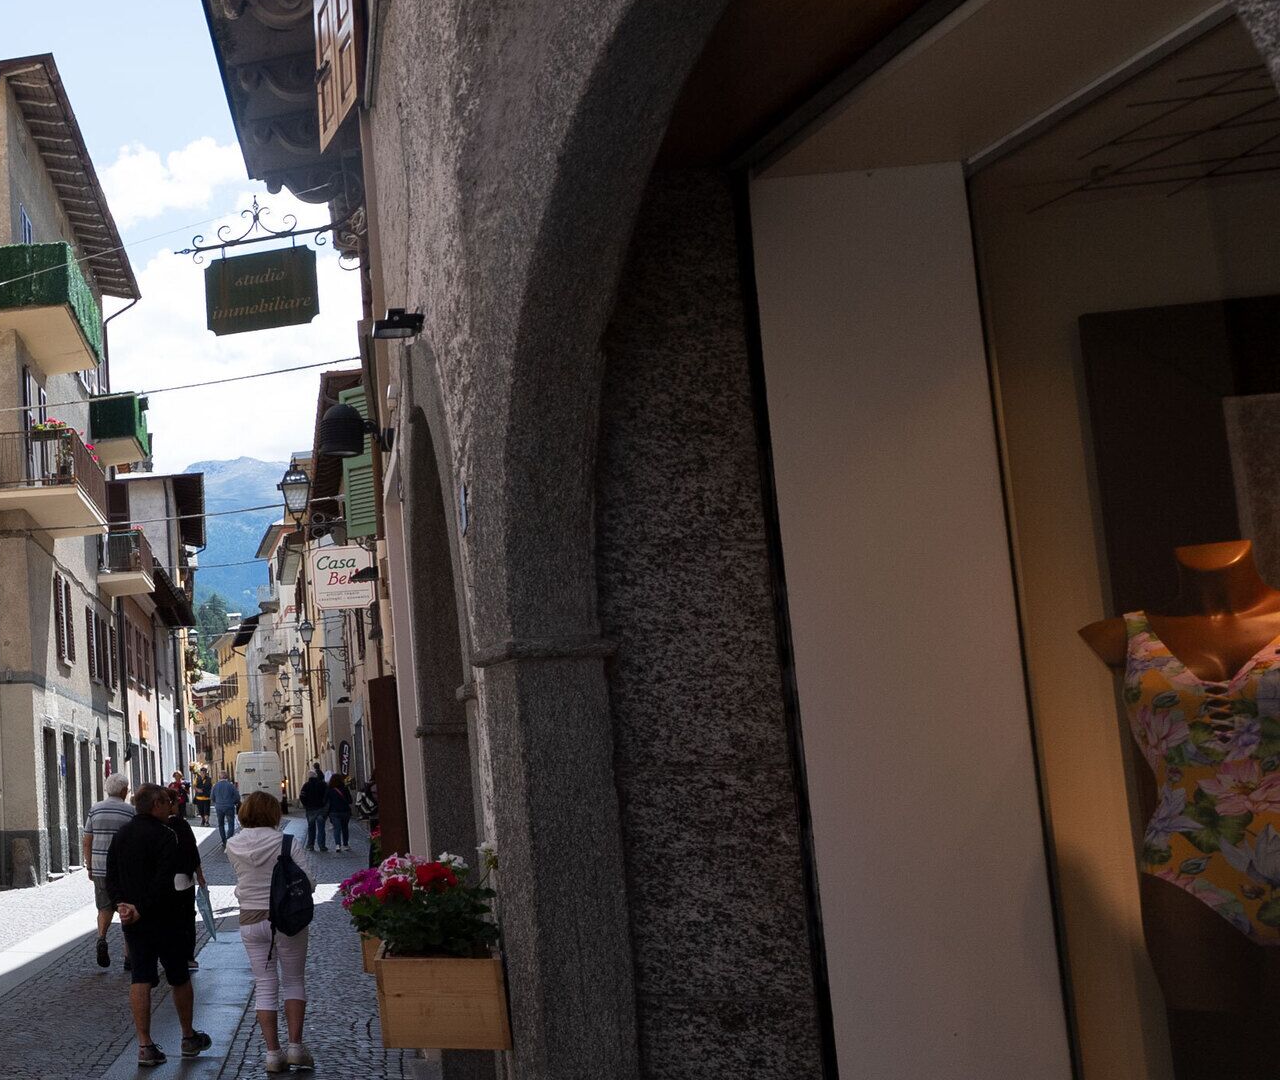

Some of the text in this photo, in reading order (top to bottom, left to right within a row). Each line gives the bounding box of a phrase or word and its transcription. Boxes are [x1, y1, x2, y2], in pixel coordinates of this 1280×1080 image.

[235, 267, 288, 286] studio
[212, 295, 312, 320] immobiliare
[316, 555, 357, 570] Casa
[327, 569, 368, 585] Bel
